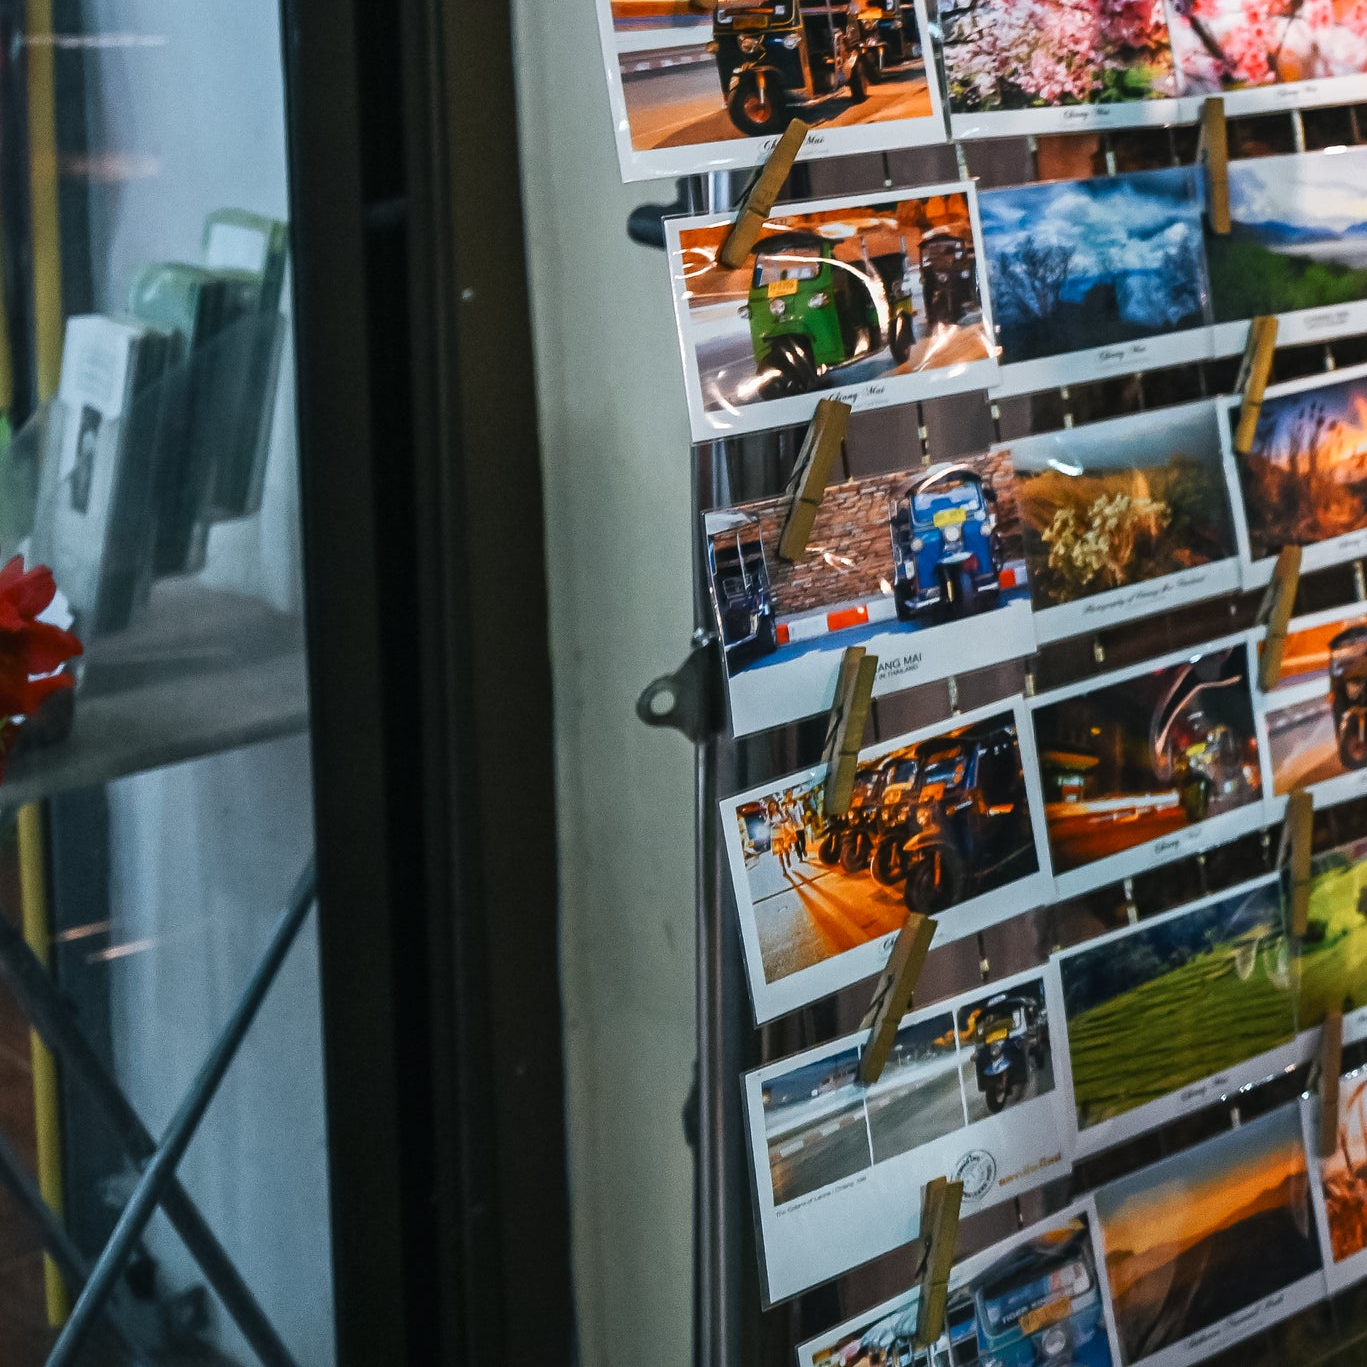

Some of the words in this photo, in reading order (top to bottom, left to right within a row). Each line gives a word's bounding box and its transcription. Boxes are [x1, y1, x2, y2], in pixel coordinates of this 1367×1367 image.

[878, 657, 901, 673] ANG
[904, 652, 923, 666] MAI
[888, 663, 919, 679] THAILAND
